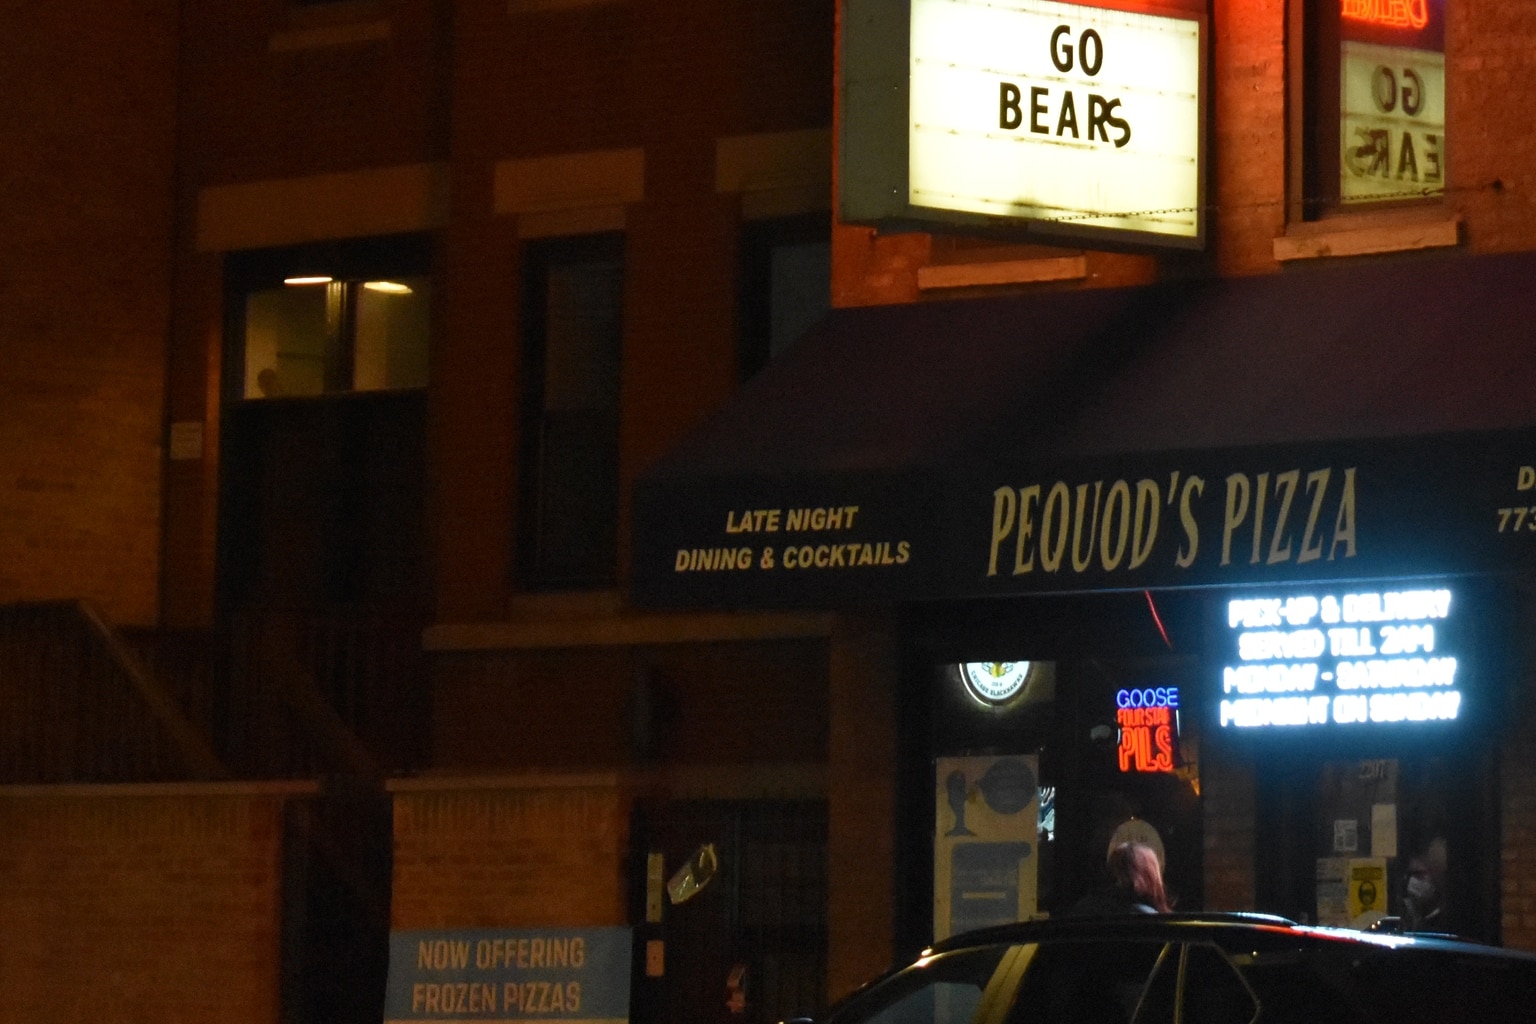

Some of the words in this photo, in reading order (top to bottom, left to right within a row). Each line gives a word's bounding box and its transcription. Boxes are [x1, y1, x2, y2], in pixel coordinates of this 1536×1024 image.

[1049, 23, 1103, 78] GO
[999, 81, 1131, 149] BEARS
[726, 510, 780, 534] LATE
[786, 506, 859, 531] NIGHT
[986, 471, 1206, 577] PEQUOD'S
[1219, 466, 1358, 567] PIZZA
[675, 547, 753, 572] DINING
[759, 546, 775, 570] &
[781, 541, 911, 569] COCKTAILS
[1342, 589, 1452, 623] DELIVERY
[1116, 687, 1179, 708] GOOSE
[1118, 725, 1174, 773] PILS
[417, 939, 471, 970] NOW
[475, 937, 585, 969] OFFERING
[411, 983, 498, 1013] FROZEN
[503, 981, 581, 1013] PIZZAS
